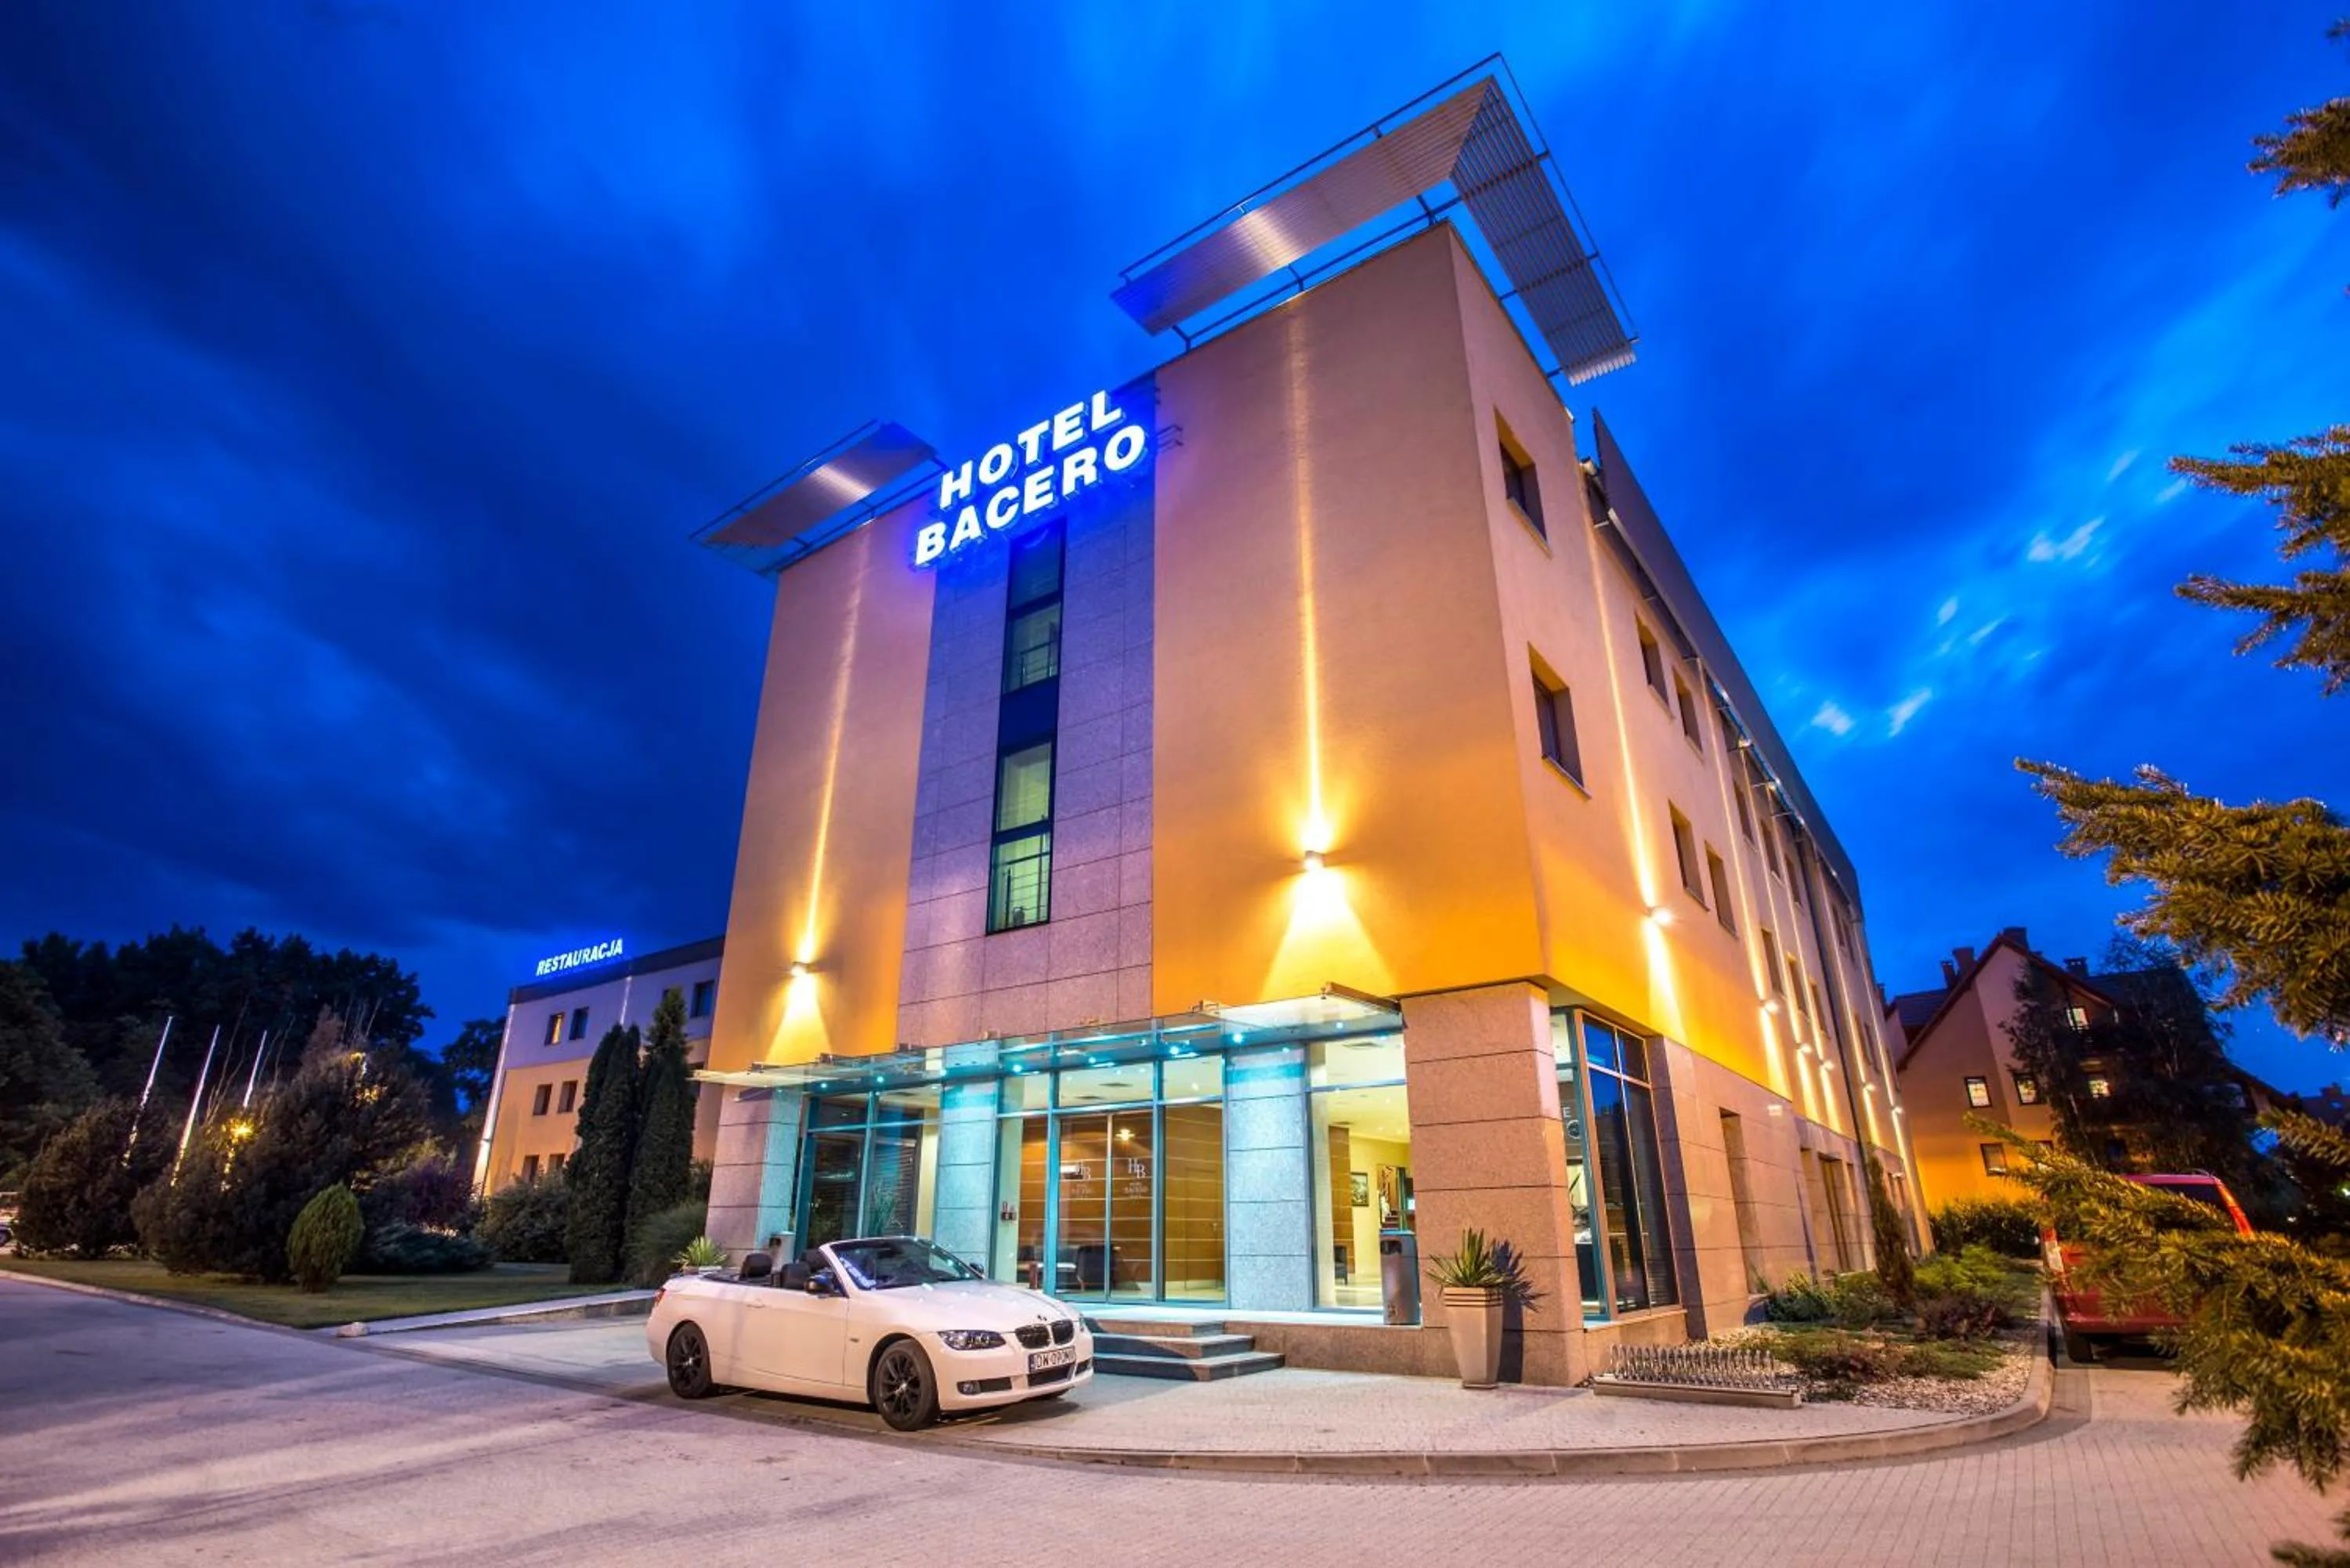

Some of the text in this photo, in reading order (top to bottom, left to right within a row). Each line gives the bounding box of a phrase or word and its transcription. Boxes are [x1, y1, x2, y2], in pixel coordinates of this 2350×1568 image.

[916, 425, 1146, 565] BACERO
[941, 390, 1123, 509] HOTEL
[536, 938, 623, 976] RESTAURACJA
